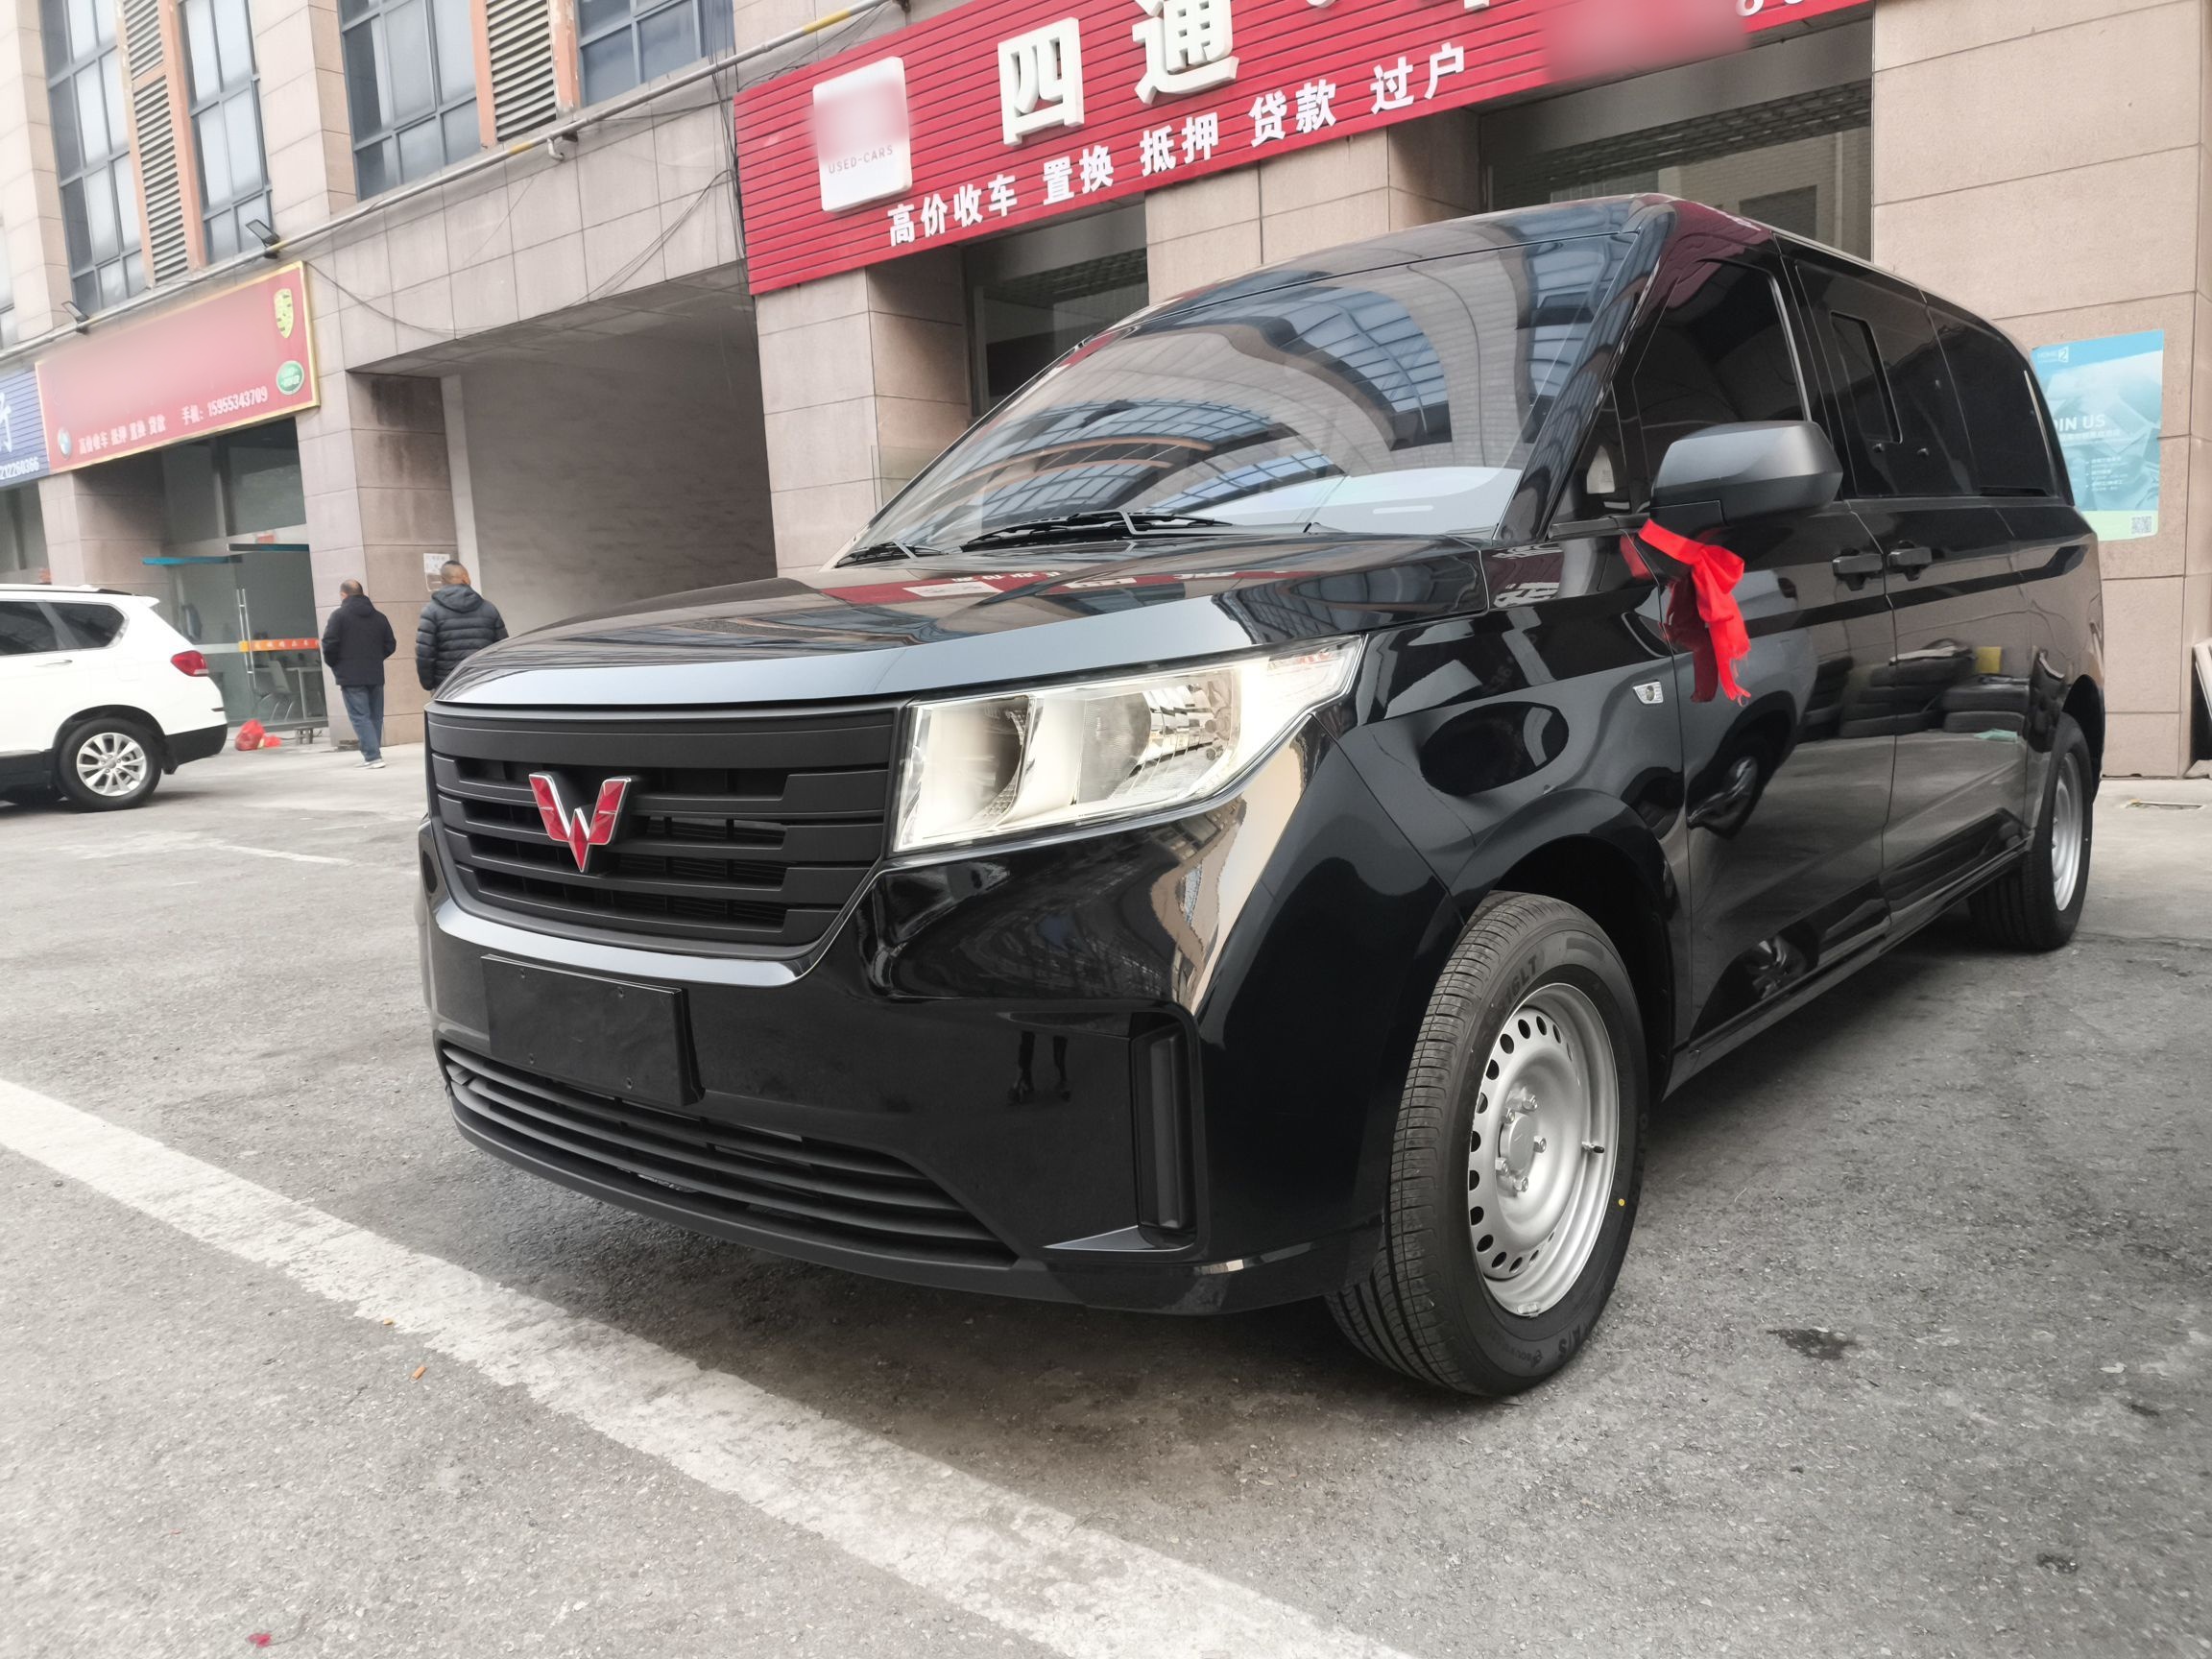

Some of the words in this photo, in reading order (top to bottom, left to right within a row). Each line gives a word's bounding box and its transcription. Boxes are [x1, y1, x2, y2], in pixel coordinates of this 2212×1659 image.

[829, 144, 893, 174] USED-CARS
[887, 173, 1018, 247] 高价收车
[1043, 143, 1114, 205] 置换
[1139, 111, 1219, 177] 抵押
[1248, 78, 1337, 148] 贷款
[1369, 41, 1465, 114] 过户
[2081, 414, 2105, 429] US
